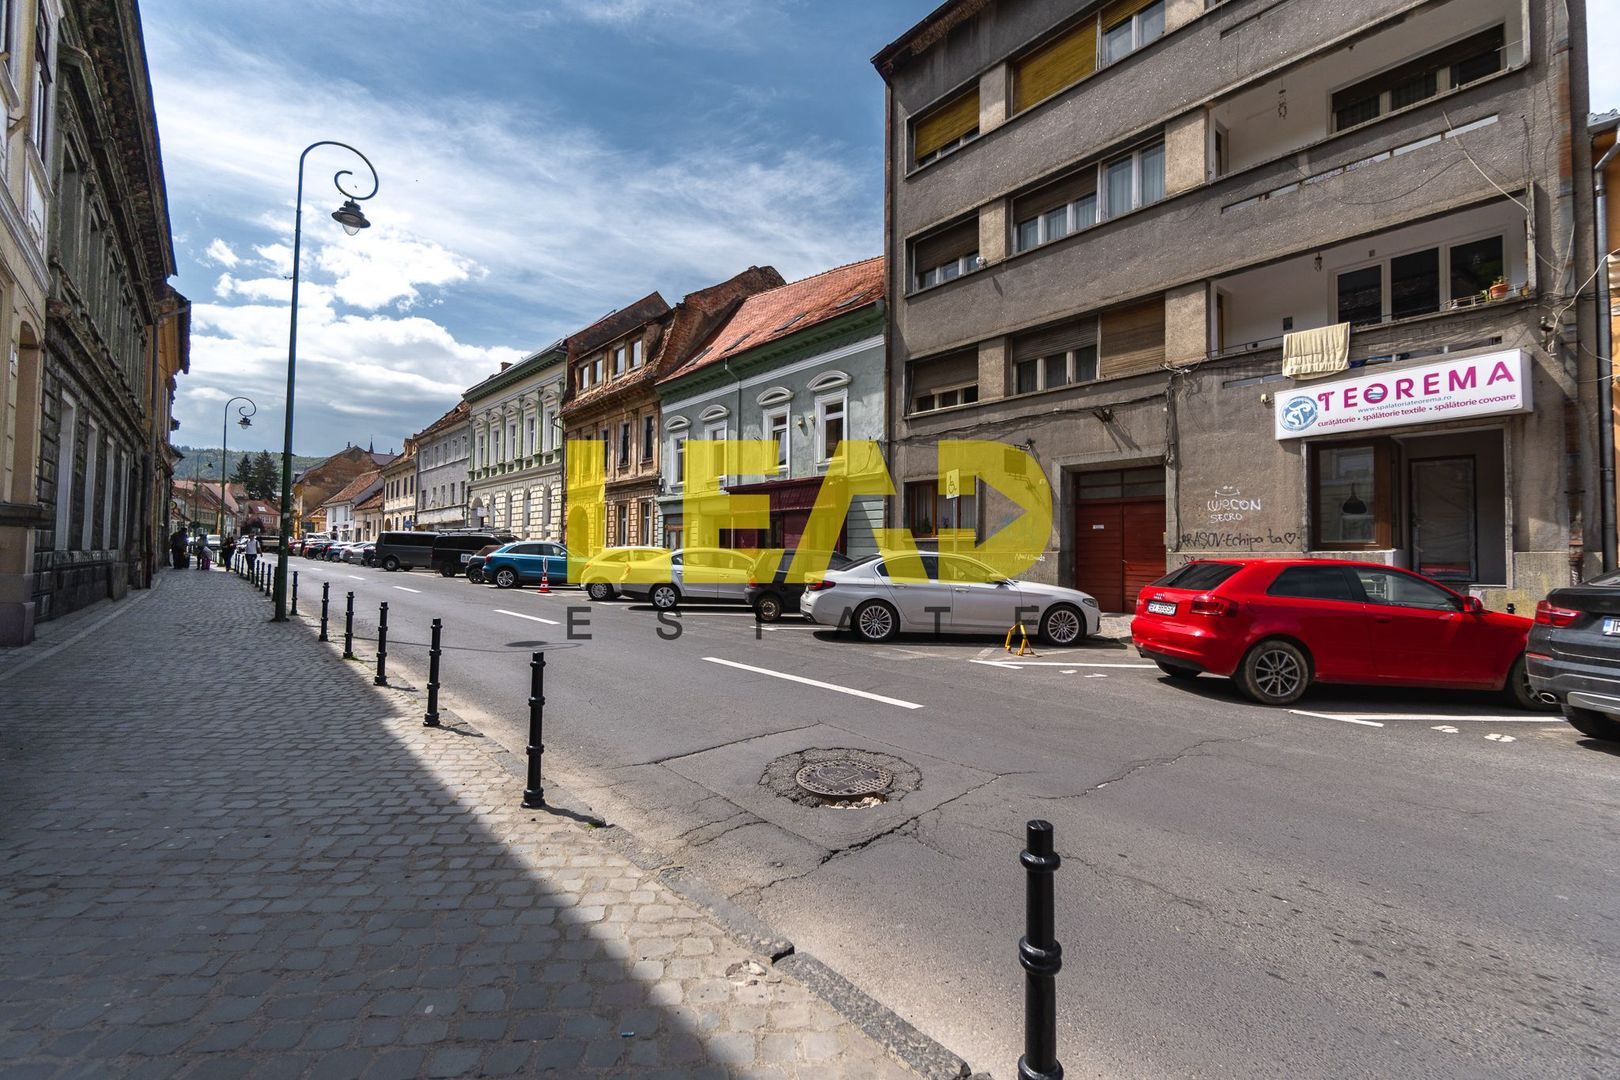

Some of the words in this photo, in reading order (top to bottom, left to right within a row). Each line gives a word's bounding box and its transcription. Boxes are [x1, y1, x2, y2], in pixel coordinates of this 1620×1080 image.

[1317, 361, 1515, 411] TEOREMA
[1401, 405, 1426, 415] textile
[1478, 394, 1516, 405] covoare
